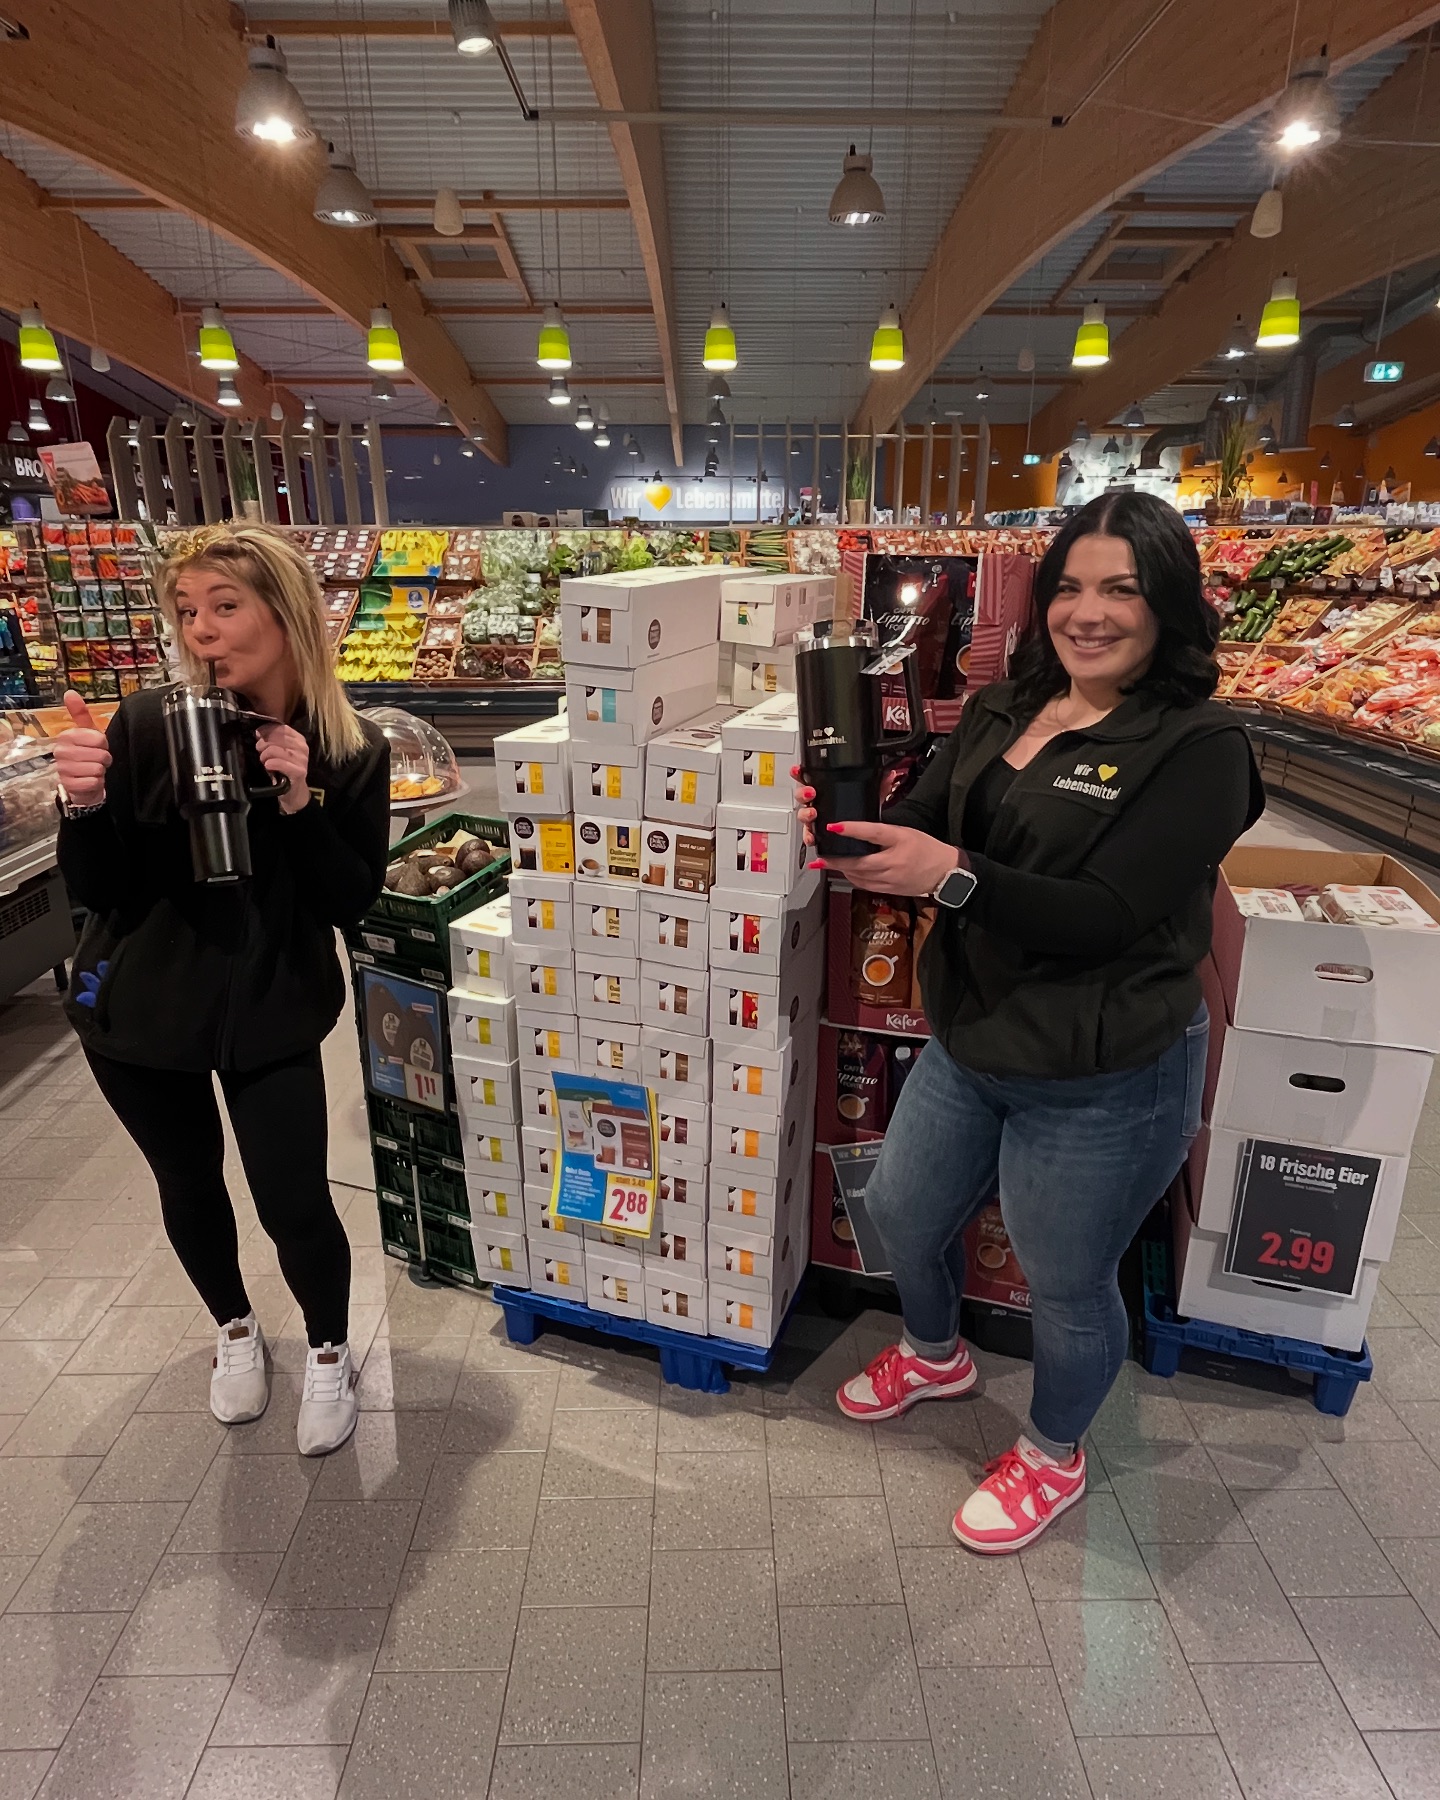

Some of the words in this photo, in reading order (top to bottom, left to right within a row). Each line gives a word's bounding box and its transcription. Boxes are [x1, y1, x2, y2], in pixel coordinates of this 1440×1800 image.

[610, 486, 643, 509] Wir
[1073, 763, 1094, 776] Wir
[1052, 775, 1122, 800] Lebensmittel
[885, 1013, 925, 1030] Käfer
[1260, 1154, 1275, 1171] 18
[1279, 1157, 1335, 1180] Frische
[1338, 1166, 1369, 1186] Eier
[609, 1188, 648, 1222] 2.88
[1257, 1231, 1335, 1274] 2.99
